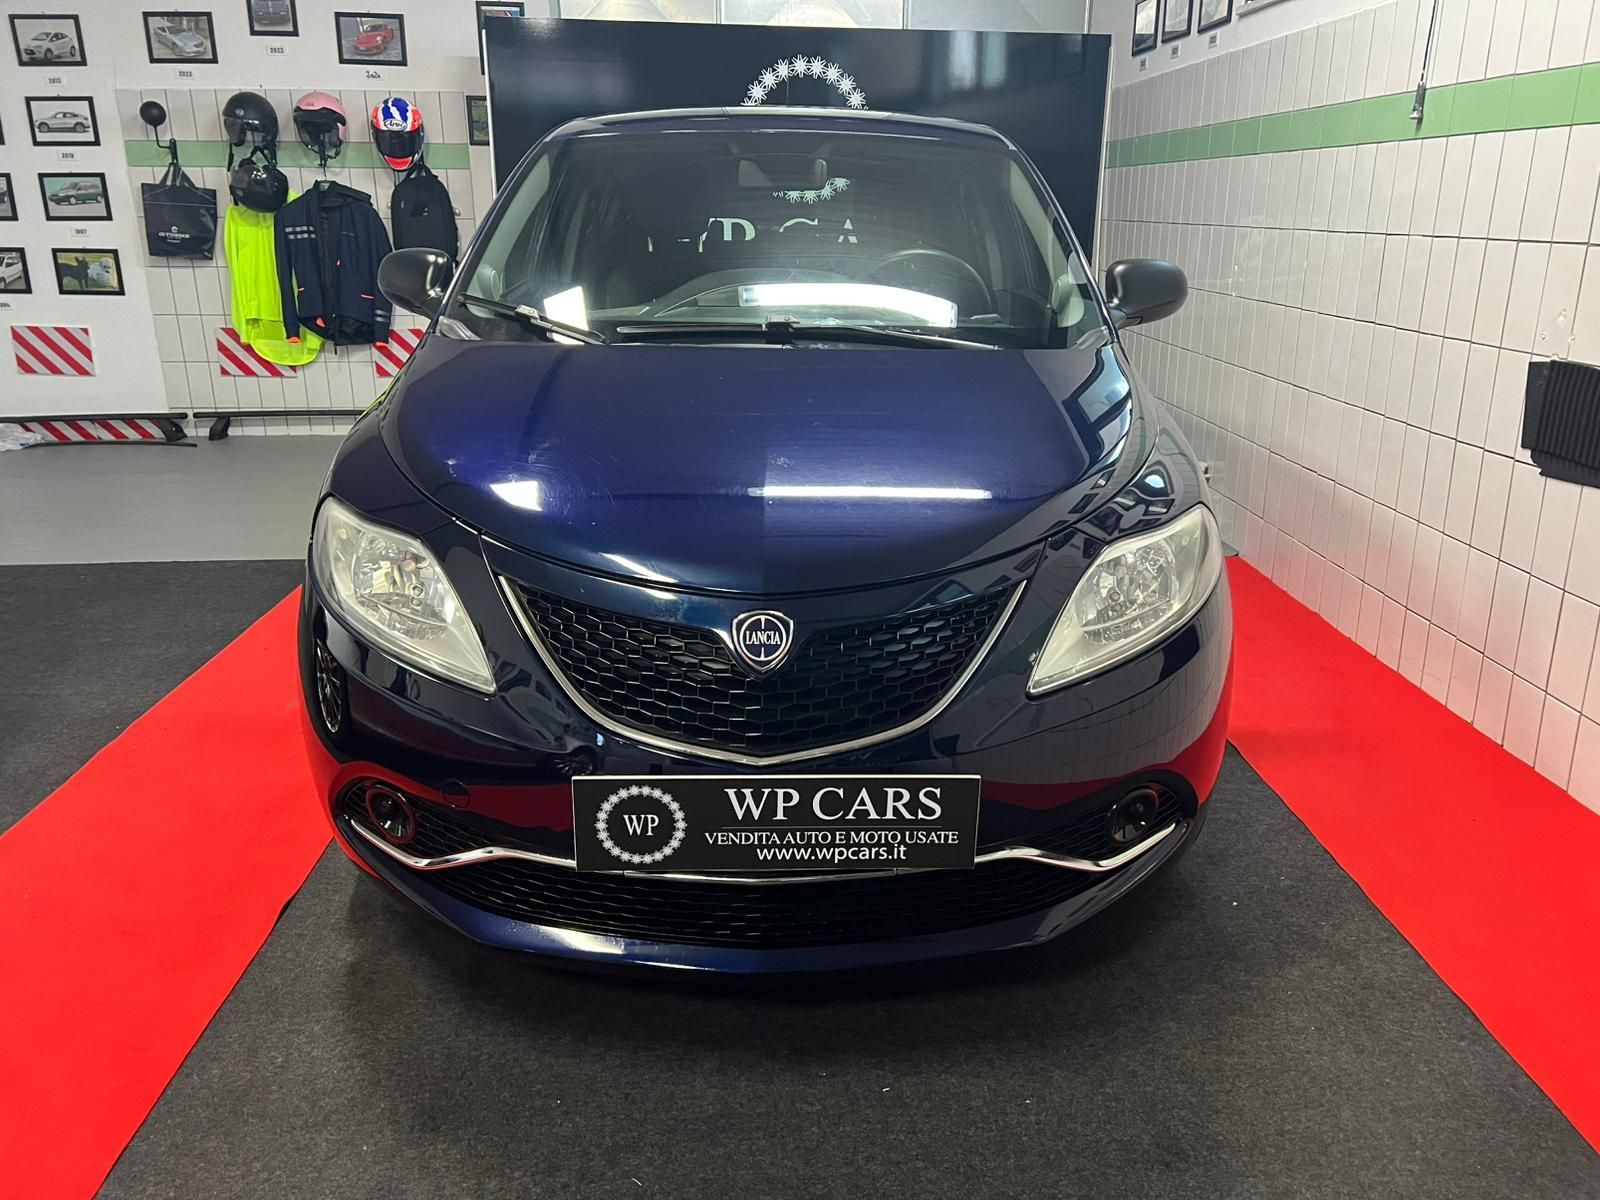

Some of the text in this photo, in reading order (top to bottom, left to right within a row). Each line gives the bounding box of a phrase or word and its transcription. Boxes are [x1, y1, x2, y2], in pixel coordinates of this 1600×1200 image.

[745, 630, 781, 645] LANCIA
[723, 786, 943, 821] WP CARS
[623, 814, 660, 836] WP
[704, 831, 960, 845] VENDITA AUTO E MOTO USATE
[756, 843, 908, 864] www.wpcars.it
